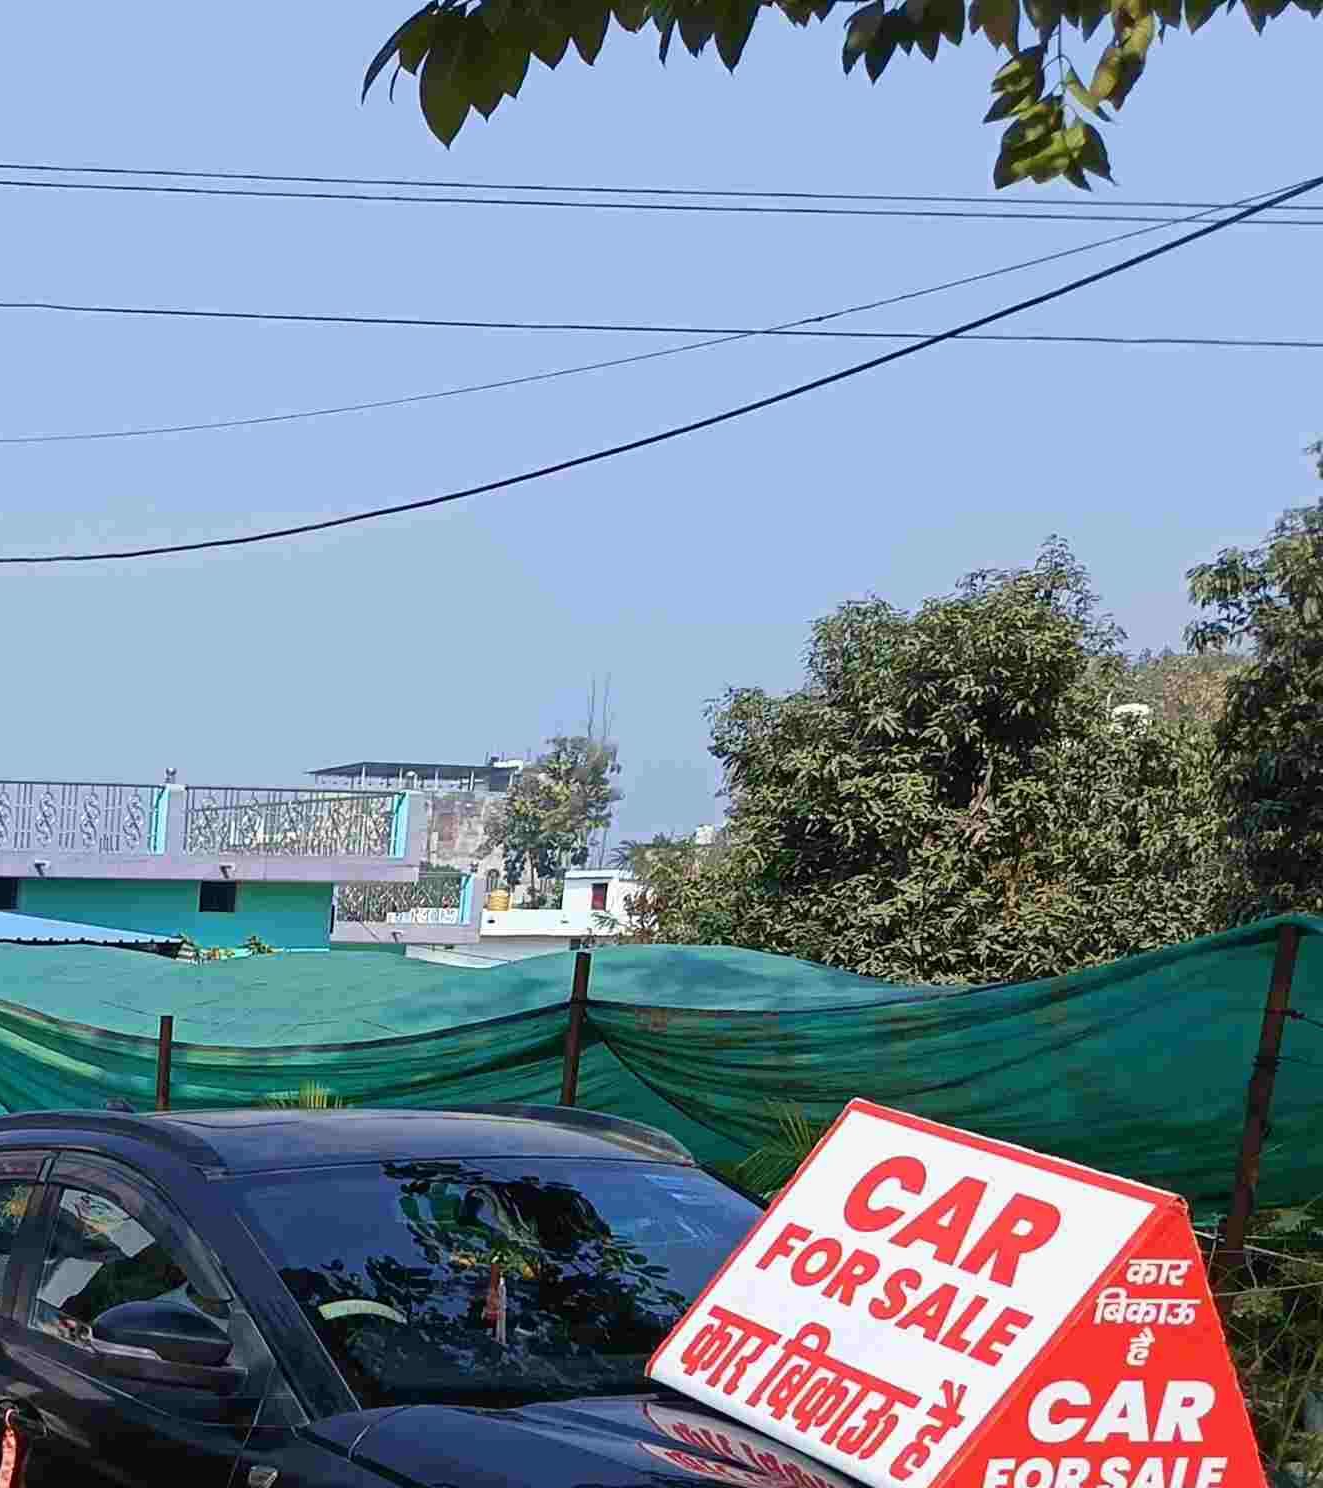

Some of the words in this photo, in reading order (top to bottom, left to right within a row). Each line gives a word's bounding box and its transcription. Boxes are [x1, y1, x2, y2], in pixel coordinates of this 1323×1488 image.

[843, 1154, 1062, 1288] CAR
[754, 1222, 880, 1307] FOR
[868, 1268, 1034, 1367] SALE
[1126, 1258, 1193, 1288] कार
[1093, 1290, 1202, 1327] बिकाऊ
[1123, 1331, 1156, 1368] है
[677, 1304, 779, 1396] कार
[746, 1322, 921, 1461] बिकाऊ
[890, 1379, 970, 1481] है
[1027, 1378, 1217, 1445] CAR
